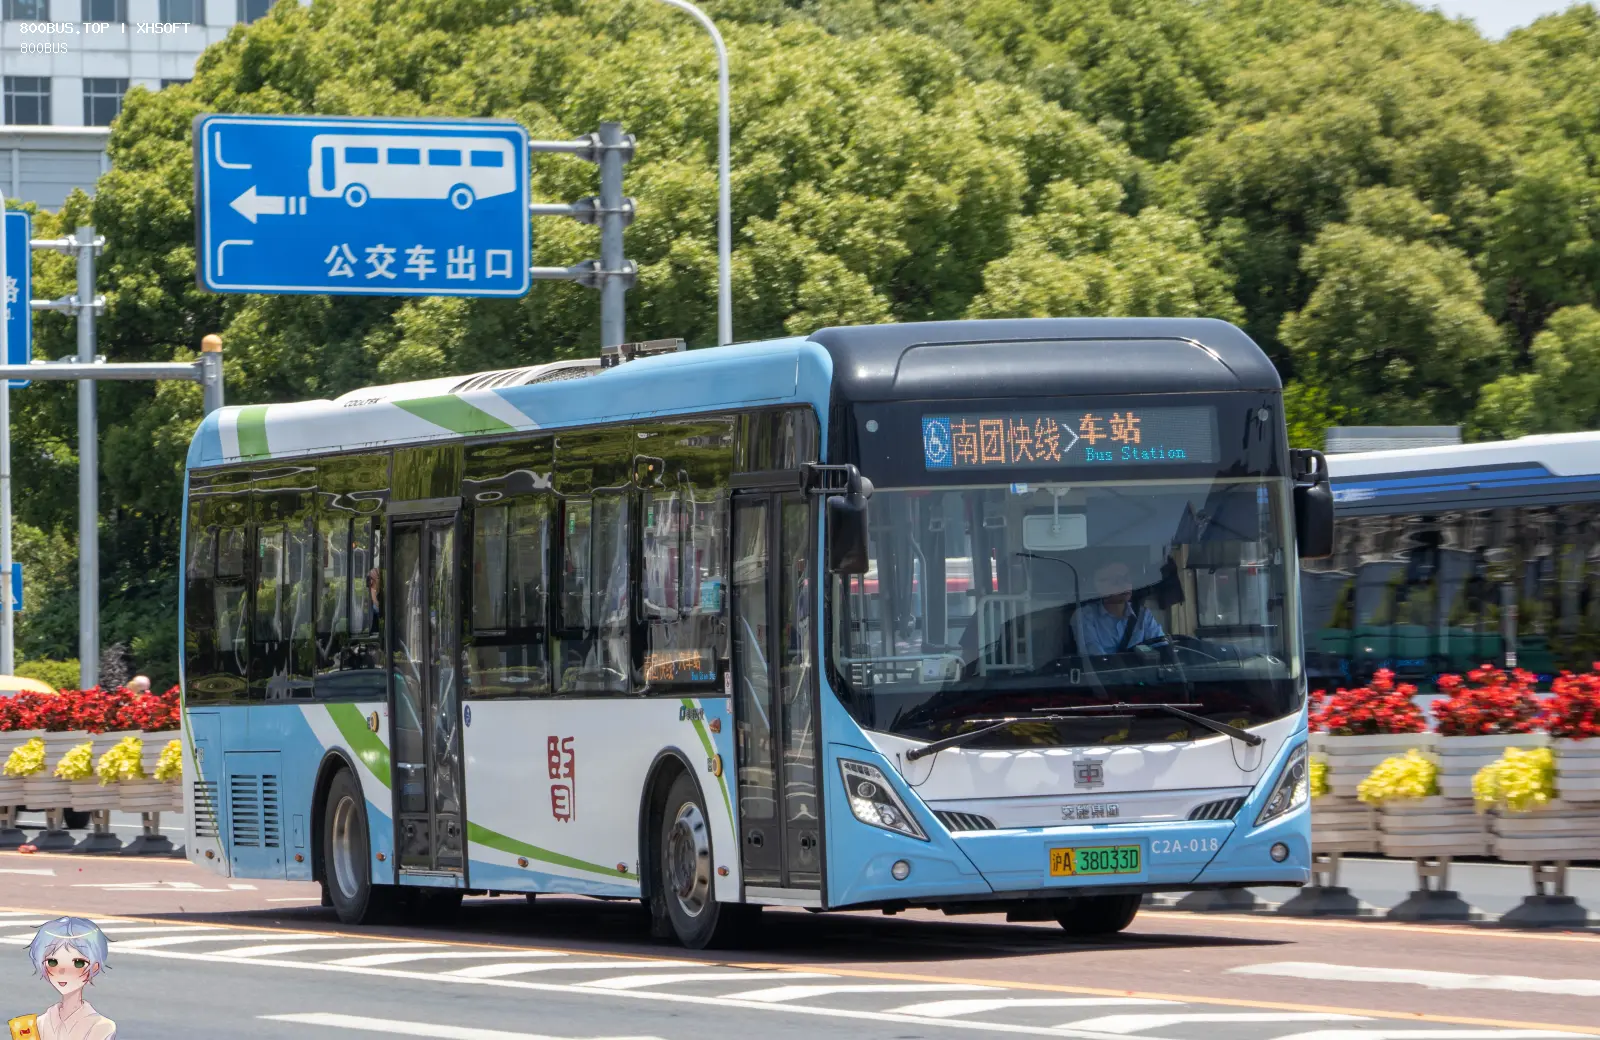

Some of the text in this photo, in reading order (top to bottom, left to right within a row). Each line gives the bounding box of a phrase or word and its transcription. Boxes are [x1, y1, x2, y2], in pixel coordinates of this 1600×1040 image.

[324, 243, 513, 282] 公交车出口
[950, 412, 1141, 466] 南团快线 车站
[1085, 446, 1186, 462] Bus Station
[1151, 838, 1218, 854] C2A-018
